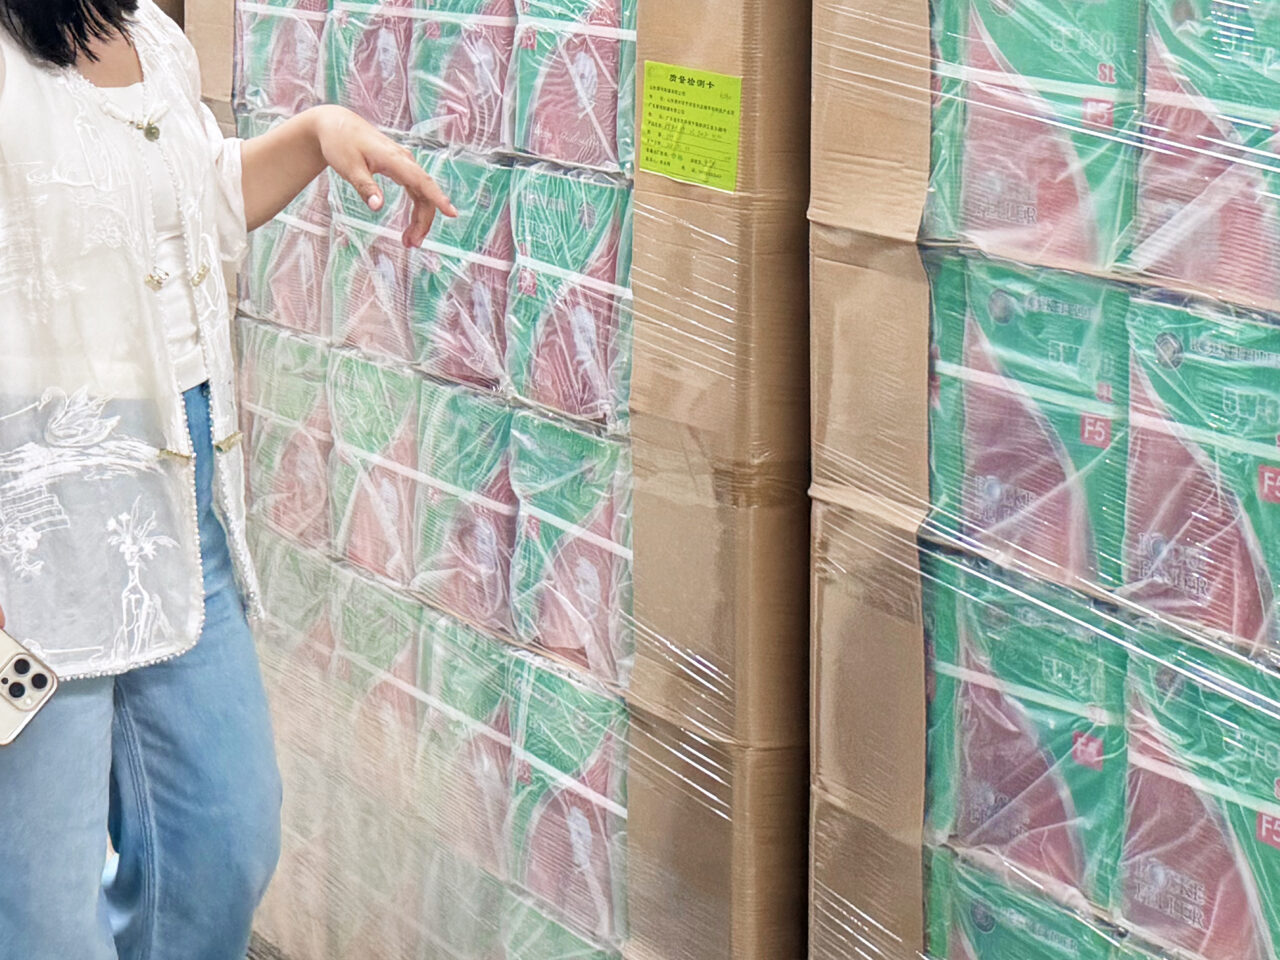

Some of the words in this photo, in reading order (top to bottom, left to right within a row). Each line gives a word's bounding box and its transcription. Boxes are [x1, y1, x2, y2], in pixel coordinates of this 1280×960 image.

[669, 74, 715, 88] 质量检测卡
[1098, 62, 1117, 84] SL
[1084, 417, 1106, 442] F5
